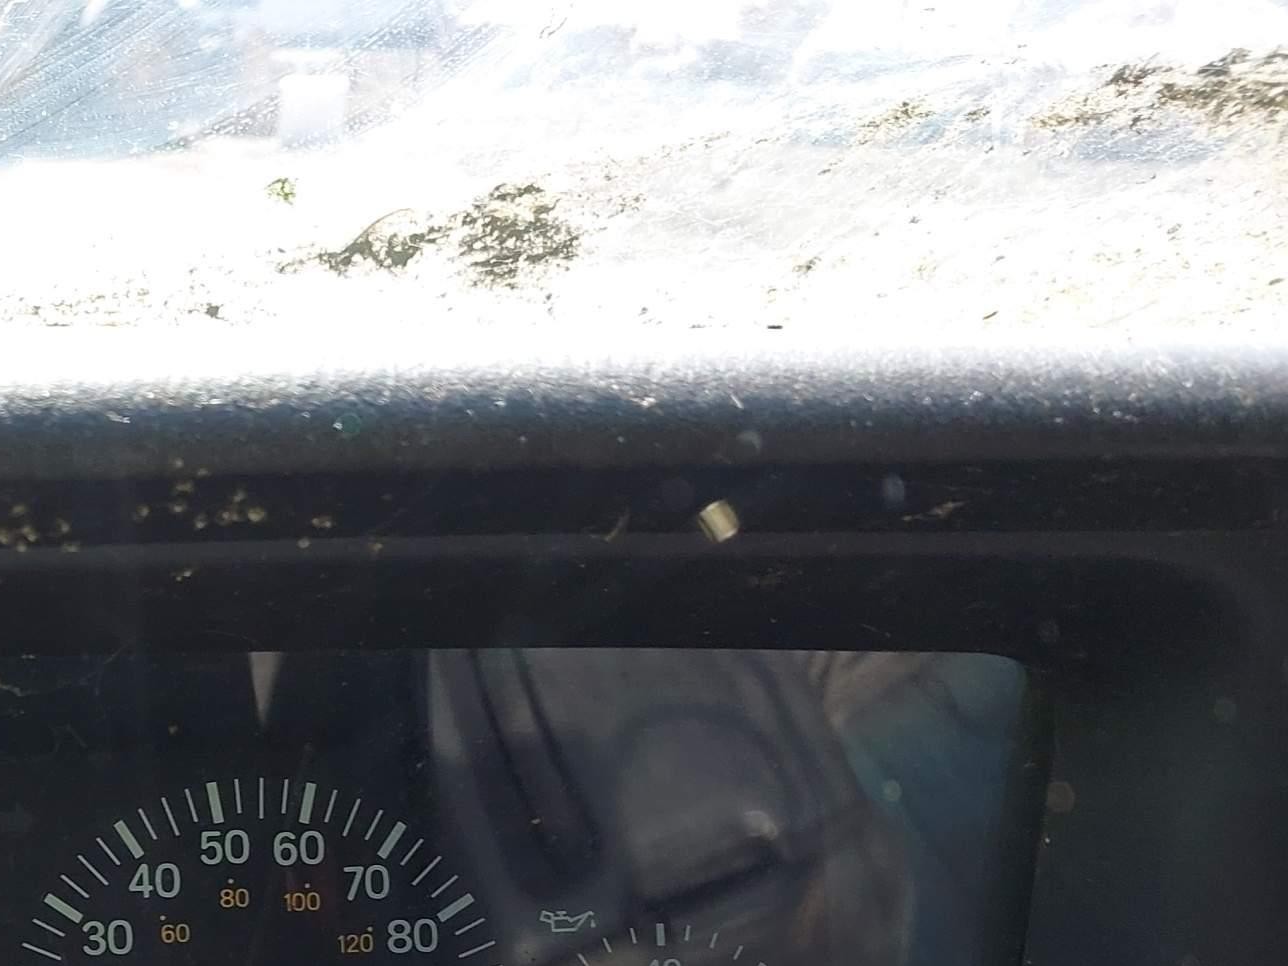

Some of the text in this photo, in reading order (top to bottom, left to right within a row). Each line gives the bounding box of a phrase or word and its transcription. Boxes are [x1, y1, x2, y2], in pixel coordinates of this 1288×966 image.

[199, 830, 250, 865] 50
[273, 831, 325, 866] 60
[129, 863, 180, 898] 40
[343, 866, 390, 901] 70
[220, 889, 249, 907] 80
[283, 893, 320, 912] 100
[82, 920, 133, 955] 30
[161, 924, 190, 943] 60
[337, 933, 373, 953] 120
[387, 919, 438, 953] 80
